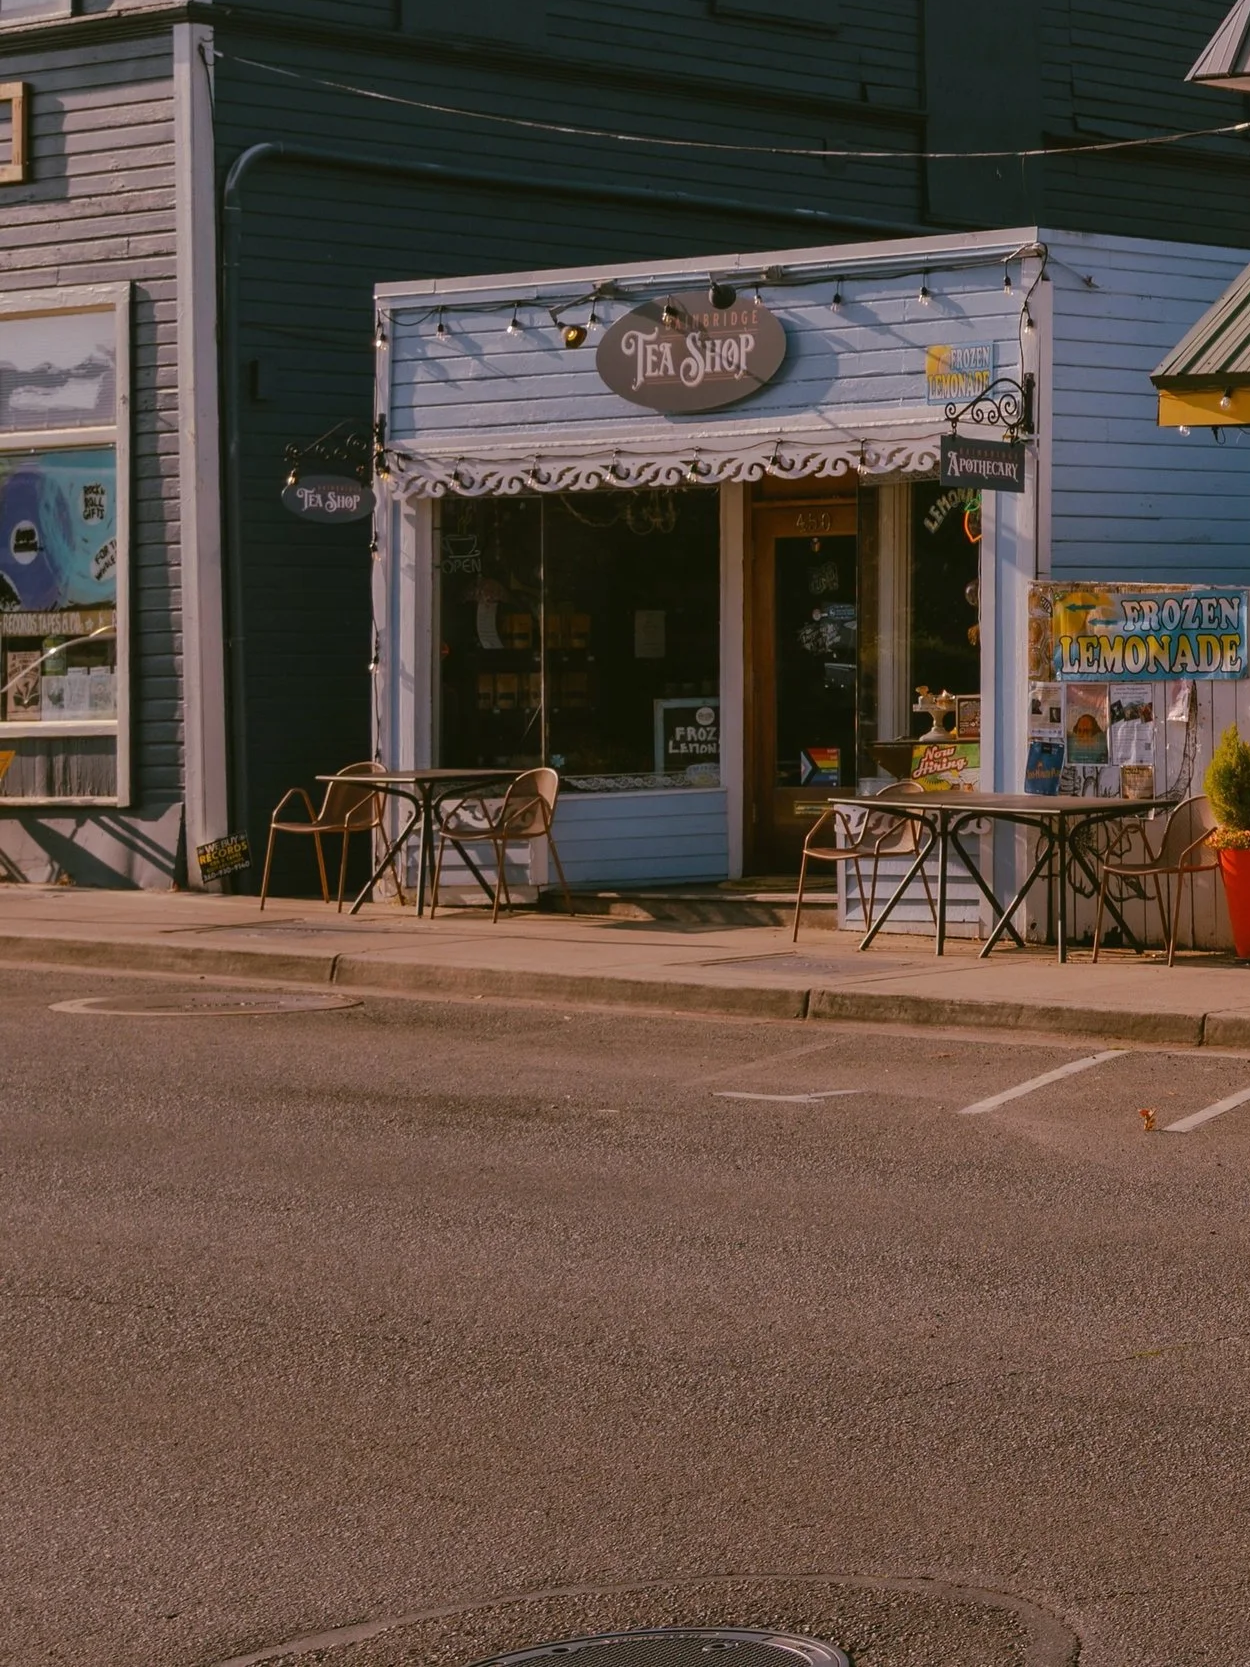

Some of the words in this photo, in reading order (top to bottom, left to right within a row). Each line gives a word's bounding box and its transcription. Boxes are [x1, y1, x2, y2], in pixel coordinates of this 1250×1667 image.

[620, 326, 676, 391] TEA
[680, 328, 756, 388] SHOP
[950, 345, 990, 370] FROZEN
[927, 371, 990, 400] LEMONADE
[946, 450, 1020, 483] APOTHECARY
[442, 558, 482, 574] OPEN
[1121, 596, 1241, 632] FROZEN
[1058, 633, 1243, 675] LEMONADE
[674, 726, 717, 742] FROZ
[922, 745, 956, 762] Now
[913, 757, 967, 778] Hiring
[199, 840, 249, 865] RECORDS
